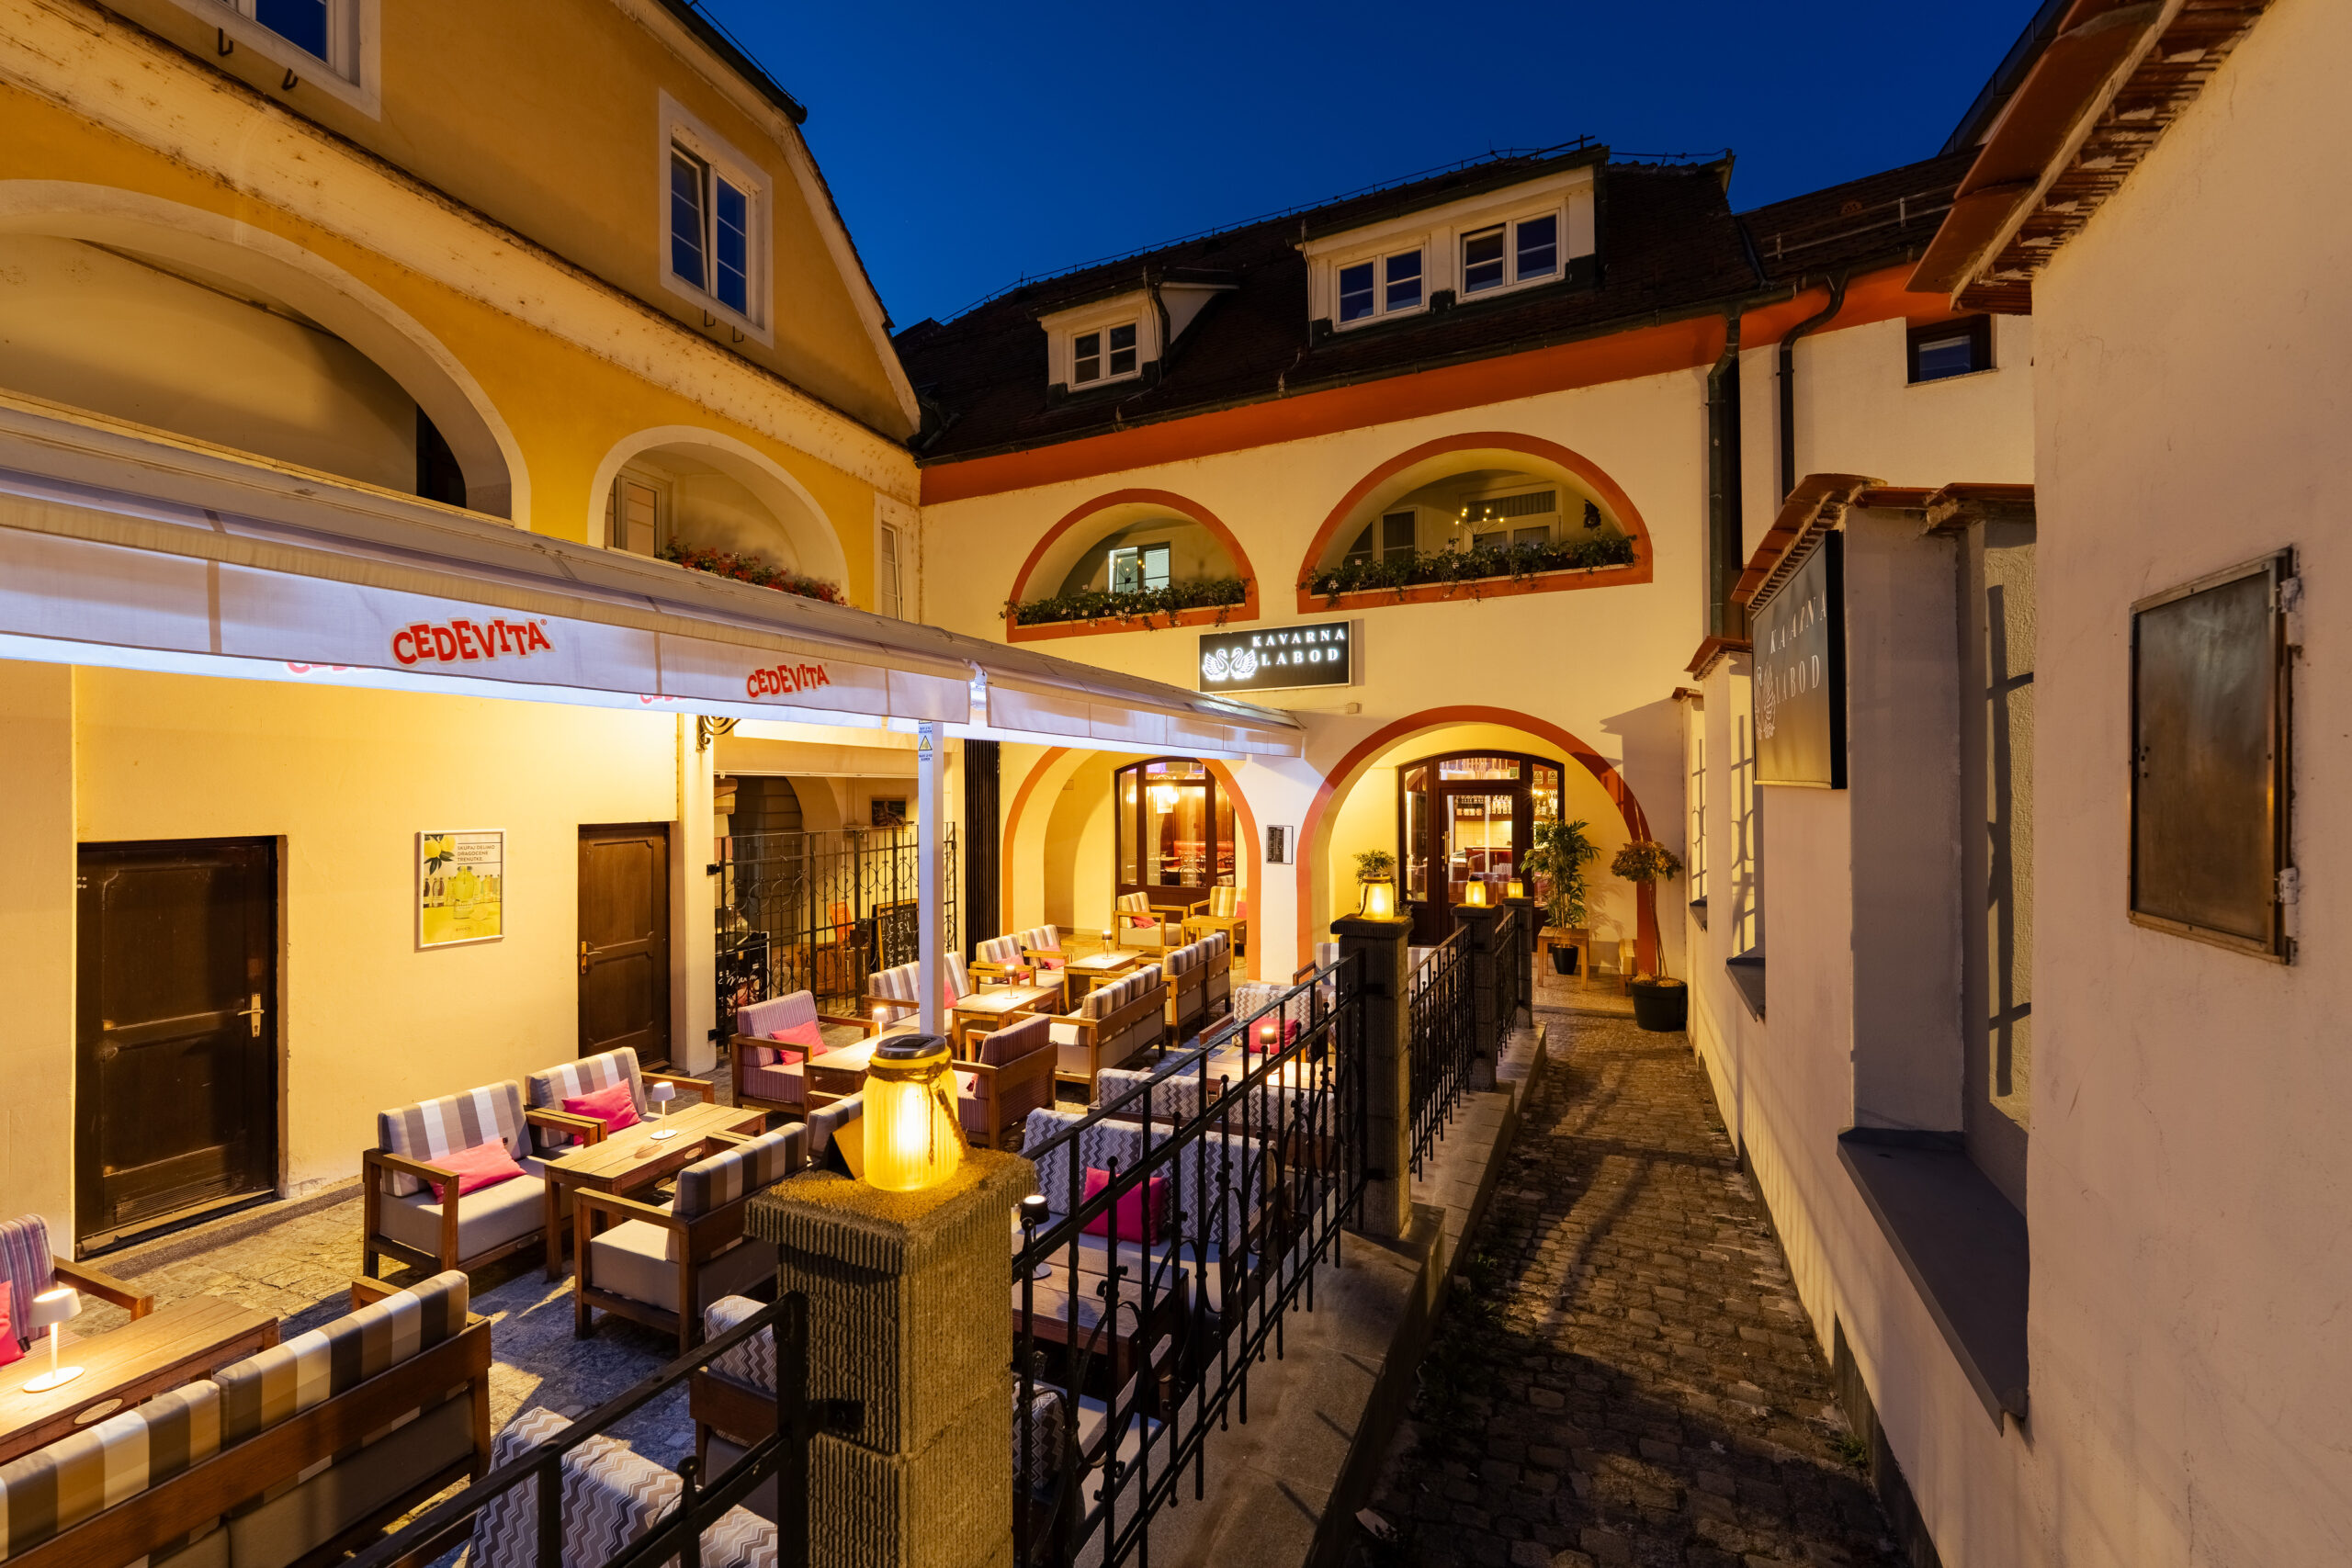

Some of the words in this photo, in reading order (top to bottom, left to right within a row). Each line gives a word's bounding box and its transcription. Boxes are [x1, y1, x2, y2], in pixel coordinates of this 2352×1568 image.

[1252, 628, 1345, 648] KAVARNA
[1770, 591, 1826, 654] KAARNA
[393, 620, 550, 665] CEDEVITA
[1261, 649, 1339, 666] LABOD
[746, 663, 830, 698] CEDEVITA
